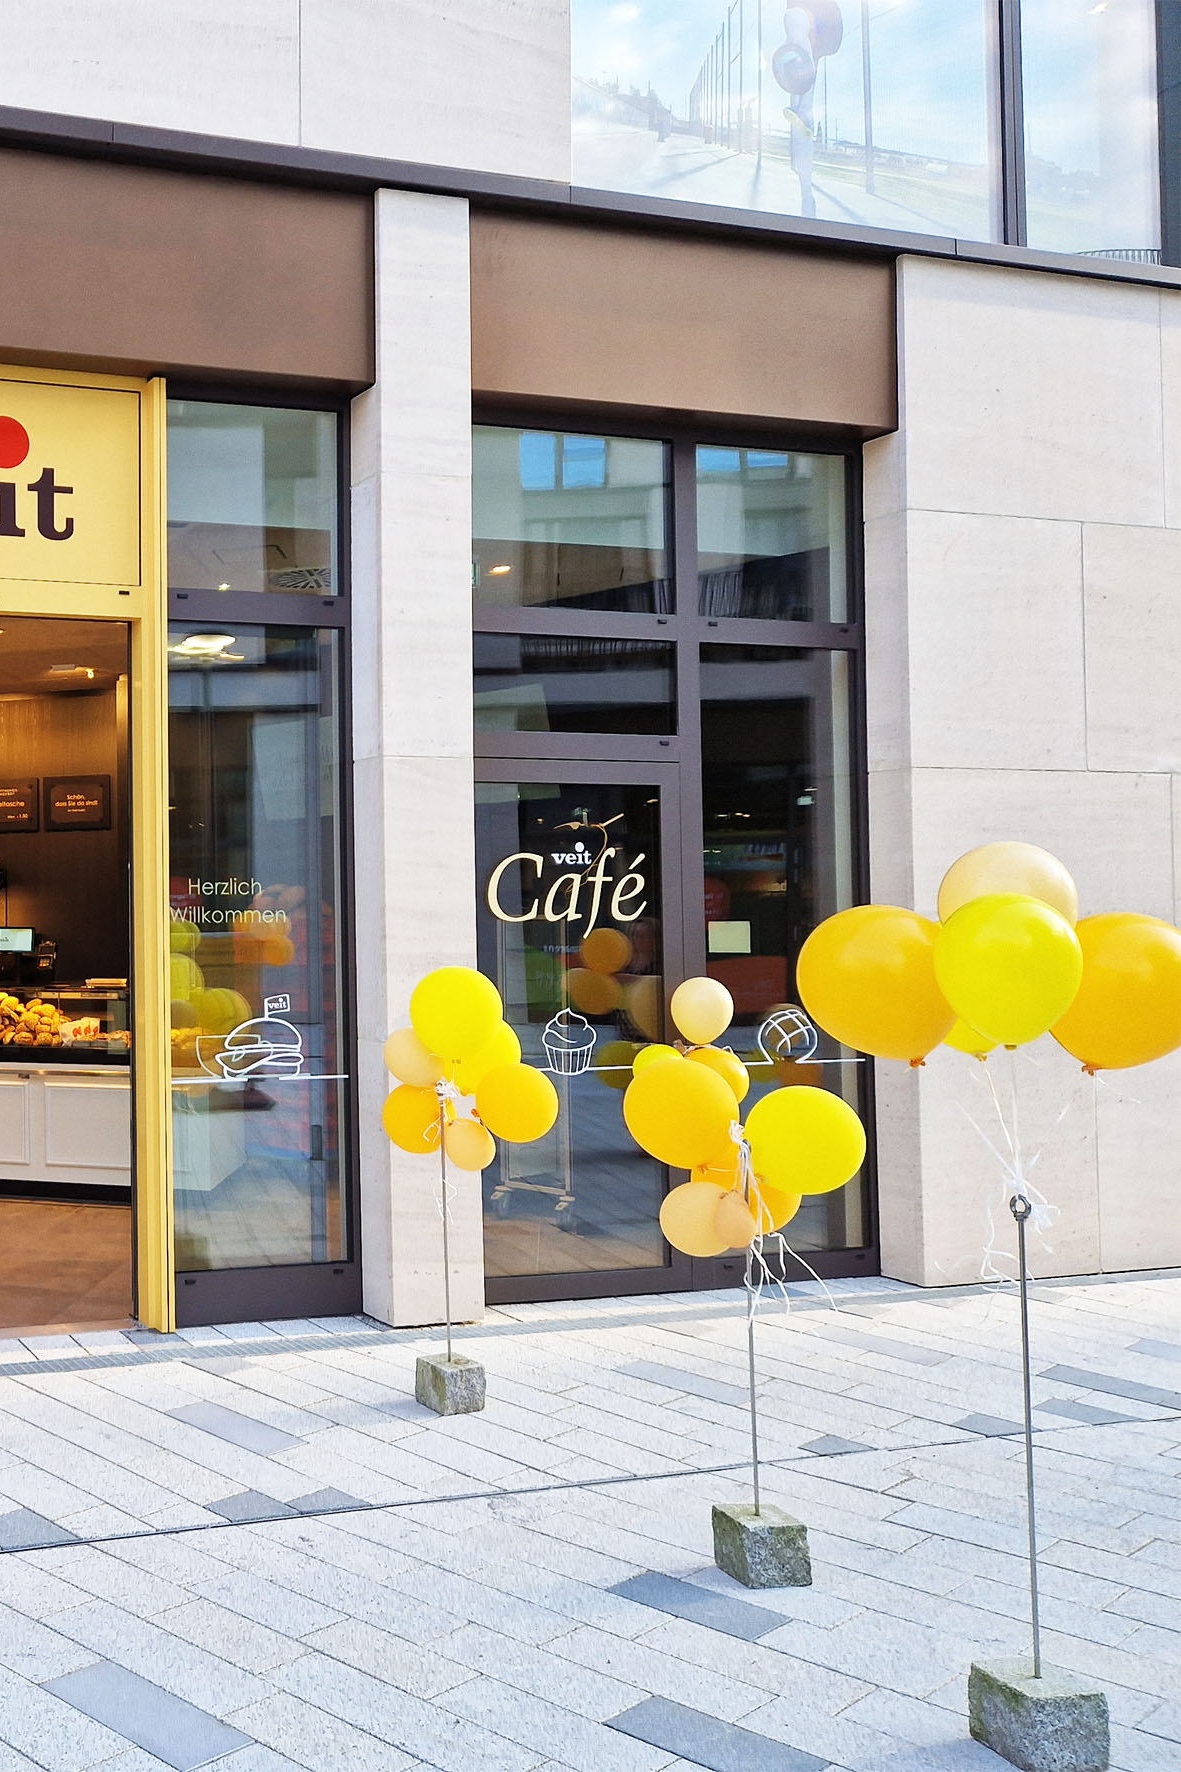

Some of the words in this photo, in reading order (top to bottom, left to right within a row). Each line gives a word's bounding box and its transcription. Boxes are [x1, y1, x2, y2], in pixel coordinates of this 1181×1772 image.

[551, 842, 593, 865] veit
[188, 877, 263, 896] Herzlich
[487, 847, 648, 939] Café
[169, 905, 287, 924] Willkommen
[268, 997, 288, 1010] veit
